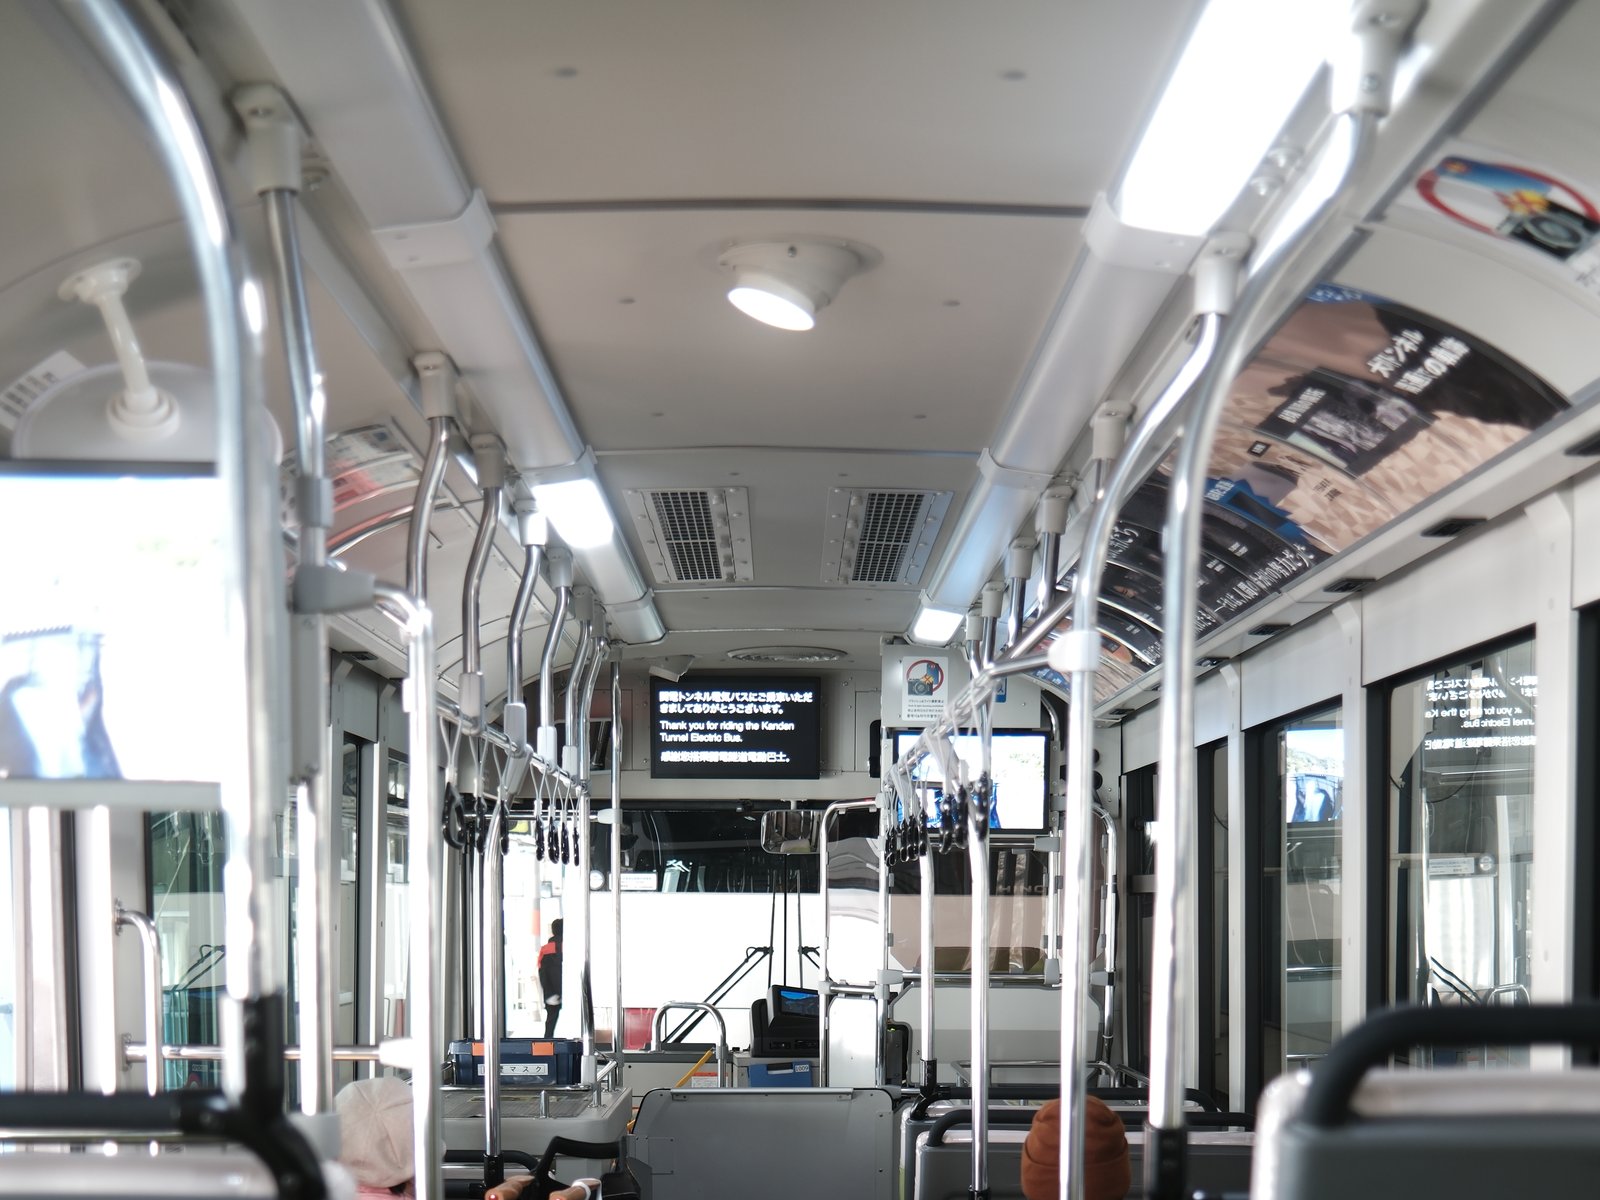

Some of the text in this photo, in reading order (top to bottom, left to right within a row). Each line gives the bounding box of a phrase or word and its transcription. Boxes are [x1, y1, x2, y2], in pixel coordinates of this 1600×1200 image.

[660, 721, 795, 732] Thank you for riding the Kanden
[660, 732, 743, 743] Tunnel Electric Bus.
